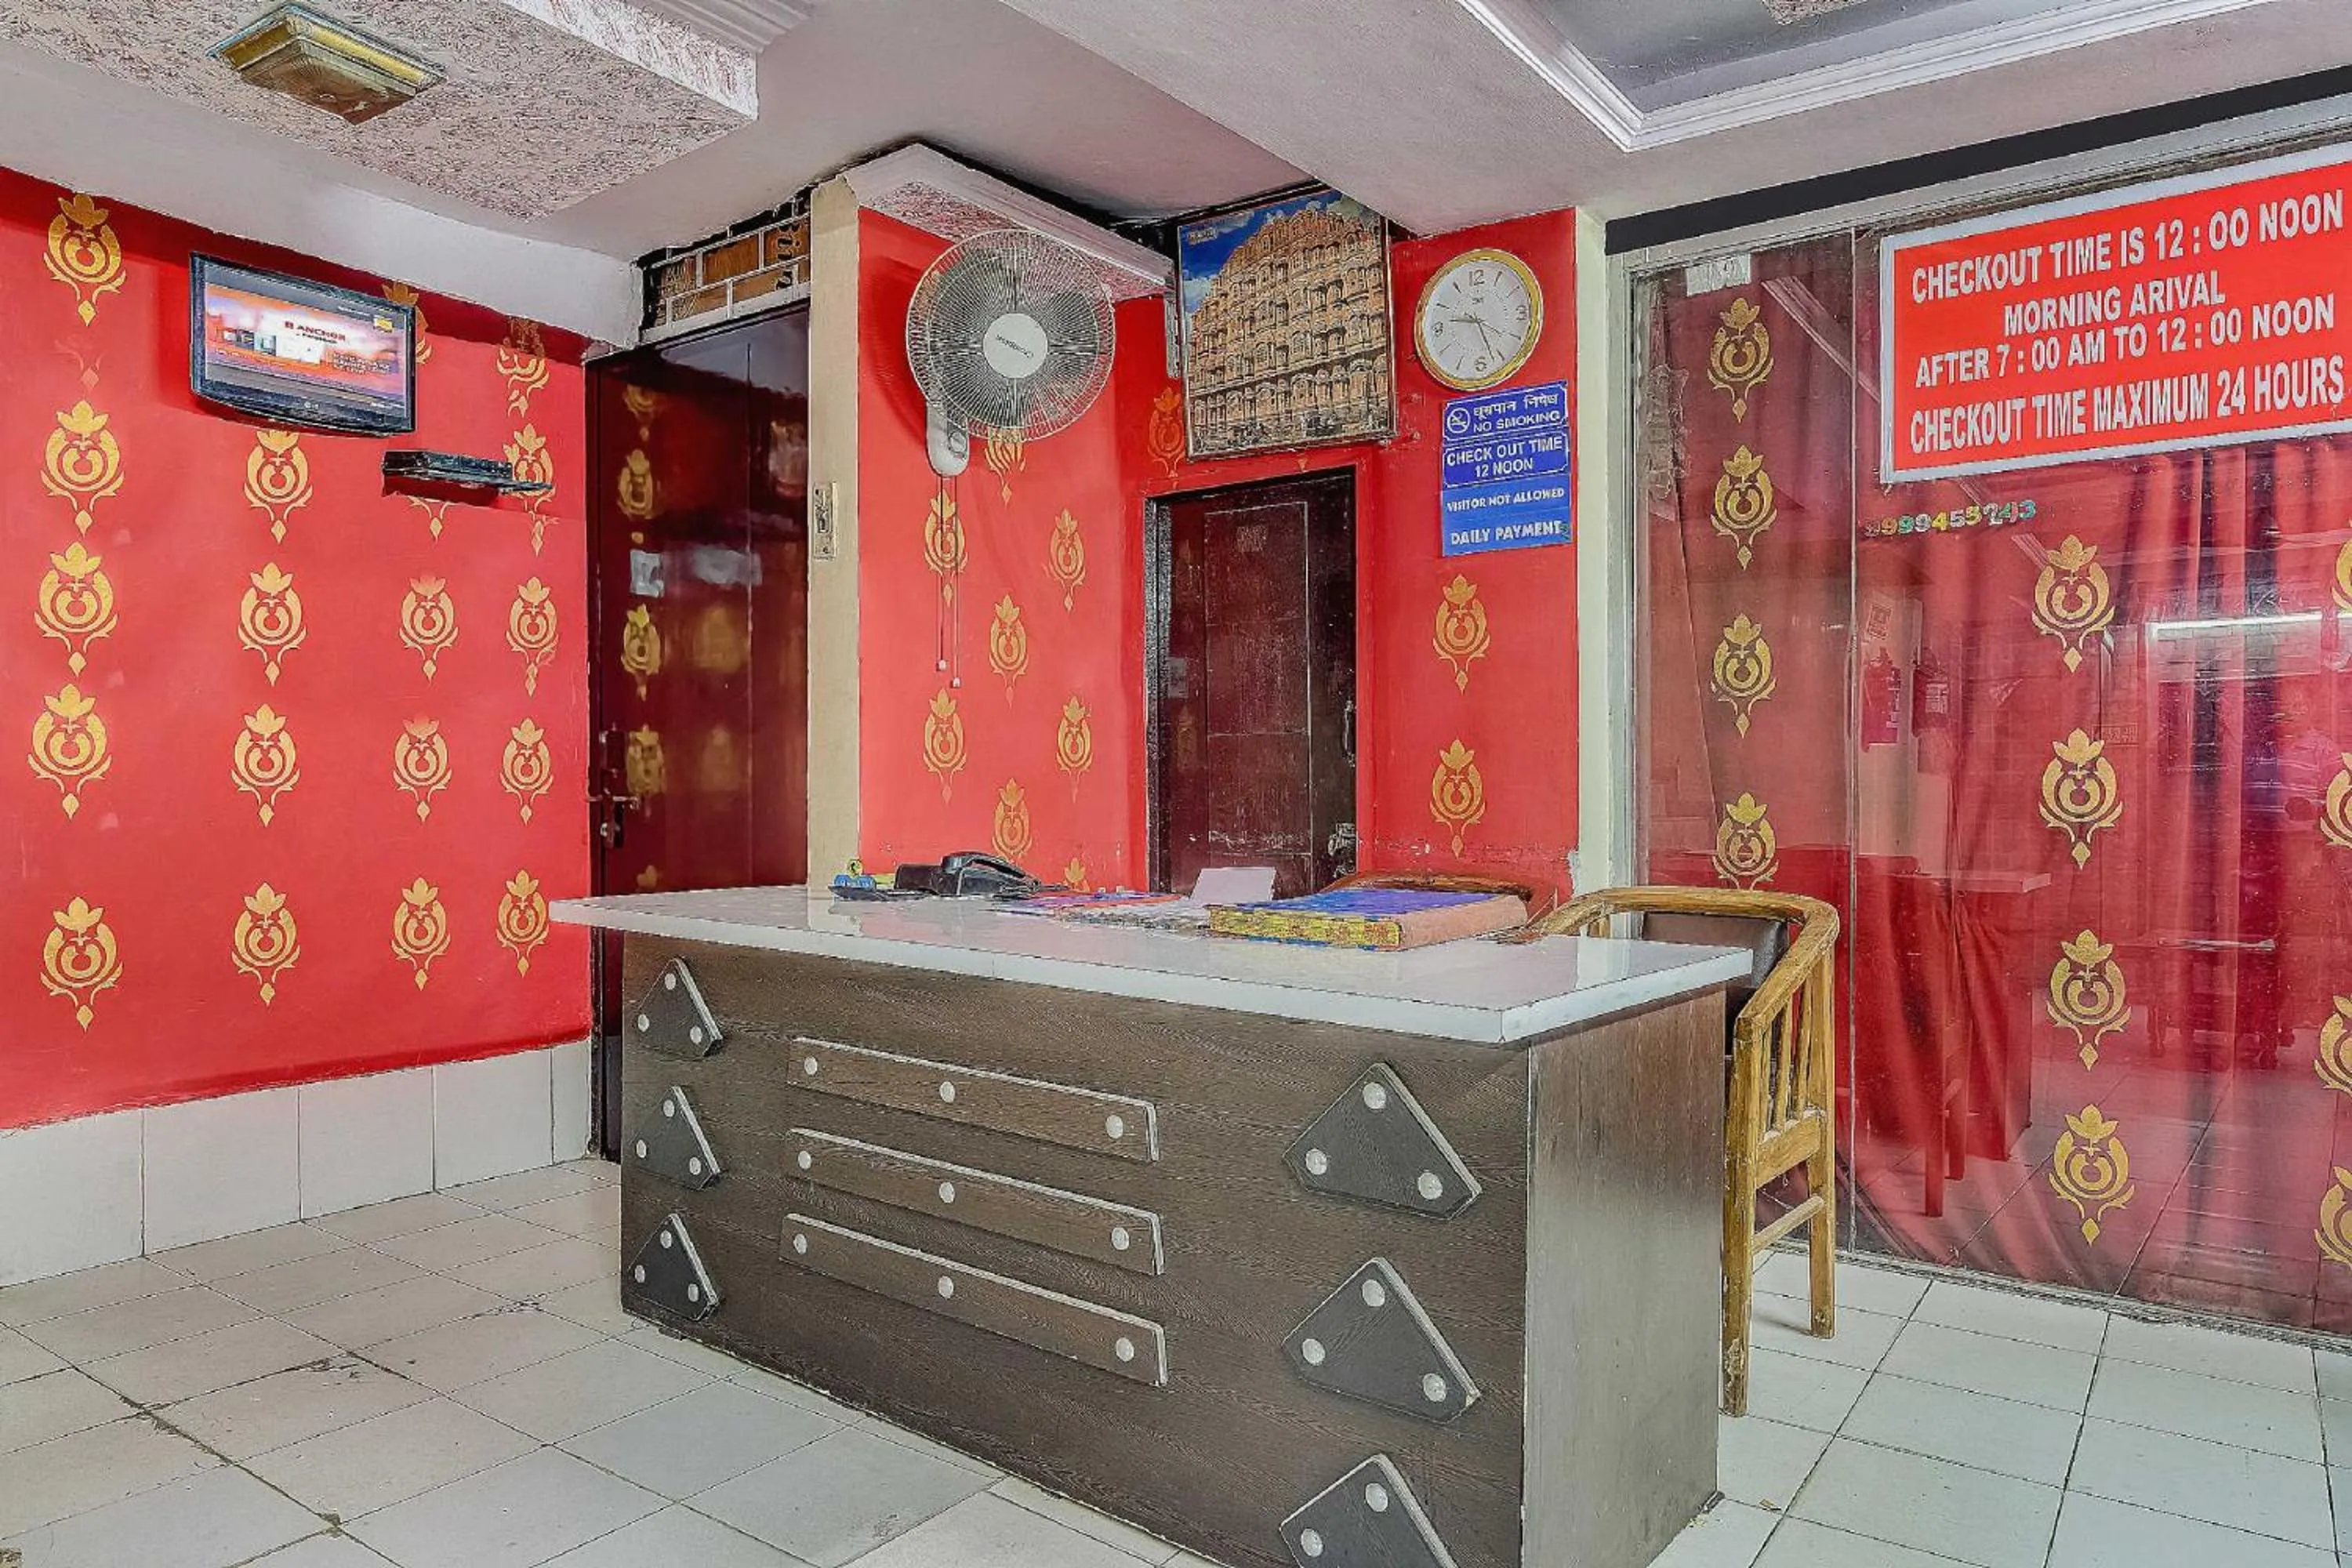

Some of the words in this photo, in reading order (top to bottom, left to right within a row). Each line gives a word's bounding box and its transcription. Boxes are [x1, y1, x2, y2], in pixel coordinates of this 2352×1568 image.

[1912, 245, 2042, 303] CHECKOUT
[2049, 232, 2111, 278] TIME
[2121, 227, 2144, 267] IS
[2154, 219, 2183, 262] 12
[2259, 189, 2343, 241] NOON
[1468, 269, 1485, 287] 12
[2004, 285, 2121, 337] MORNING
[2129, 270, 2226, 318] ARIVAL
[1915, 348, 1990, 388] AFTER
[1996, 343, 2010, 377] 7
[2067, 329, 2105, 367] AM
[2113, 322, 2147, 359] TO
[2156, 317, 2187, 353] 12
[2252, 293, 2334, 340] NOON
[1911, 397, 2027, 454] CHECKOUT
[2031, 389, 2086, 439] TIME
[2092, 372, 2209, 432] MAXIMUM
[2216, 368, 2246, 418] 24
[2254, 354, 2345, 412] HOURS
[1473, 421, 1492, 433] NO
[1496, 410, 1560, 429] SMOKING
[1446, 447, 1493, 466] CHECK
[1497, 441, 1526, 458] OUT
[1529, 436, 1563, 452] TIME
[1475, 464, 1489, 477] 12
[1493, 458, 1534, 475] NOON
[1446, 497, 1487, 512] VISITOR
[1489, 494, 1511, 506] NOT
[1513, 488, 1565, 504] ALLOWED
[1450, 528, 1490, 546] DAILY
[1495, 520, 1563, 541] PAYMENT
